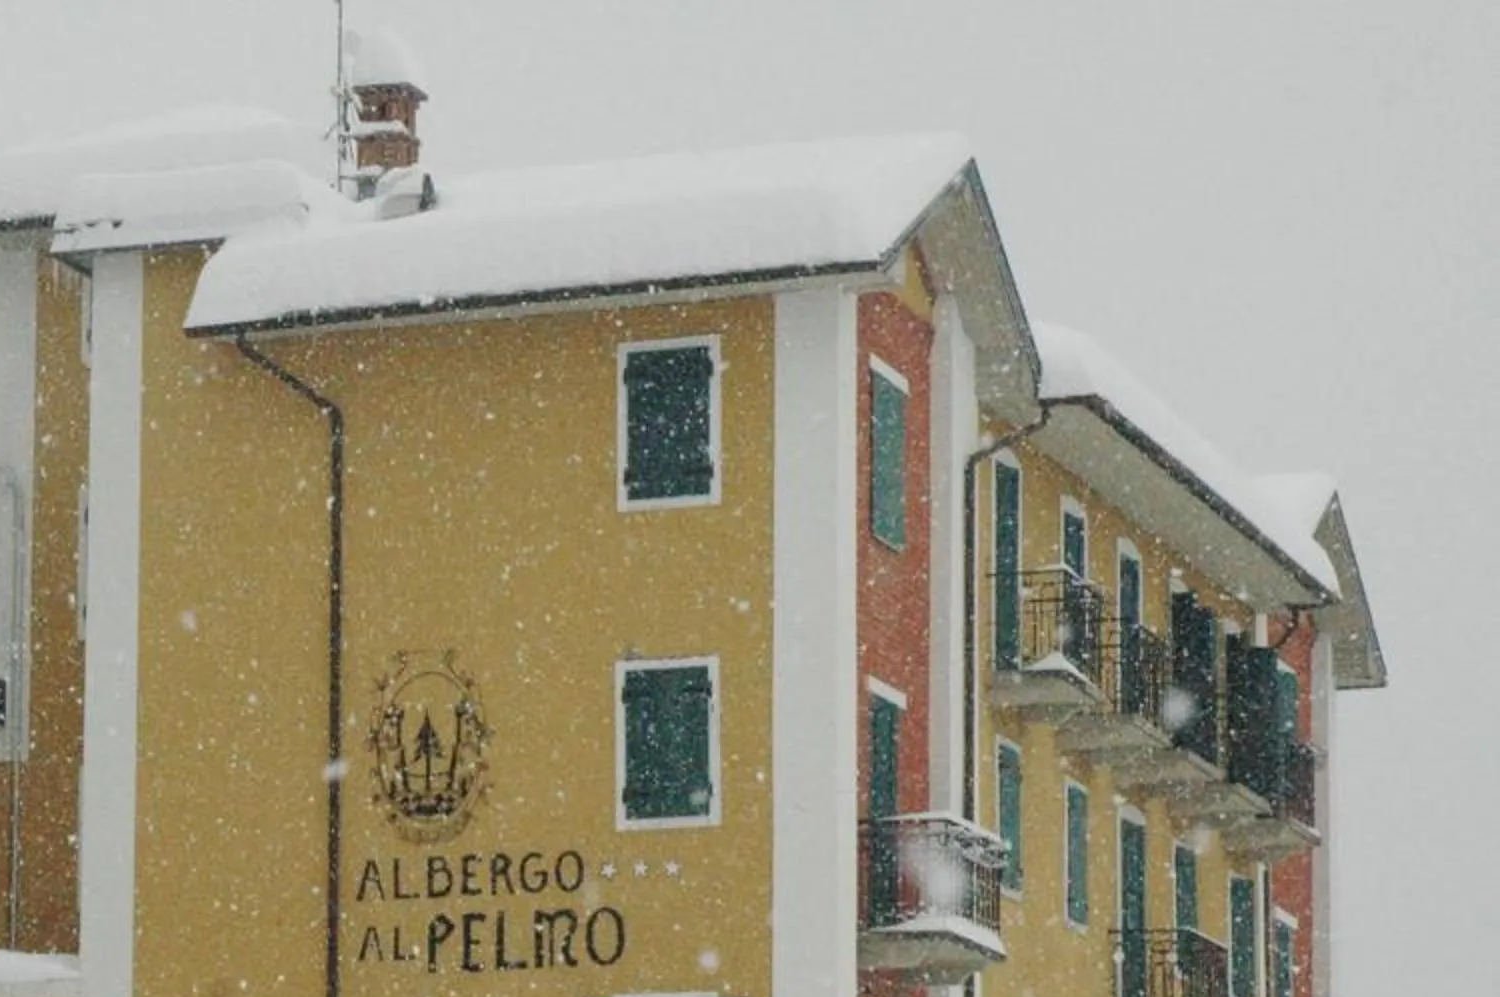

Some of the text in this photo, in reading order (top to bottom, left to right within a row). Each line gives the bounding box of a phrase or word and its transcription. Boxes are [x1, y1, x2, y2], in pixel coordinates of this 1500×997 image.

[355, 850, 585, 901] ALBERGO
[358, 906, 626, 973] AL PELMO
